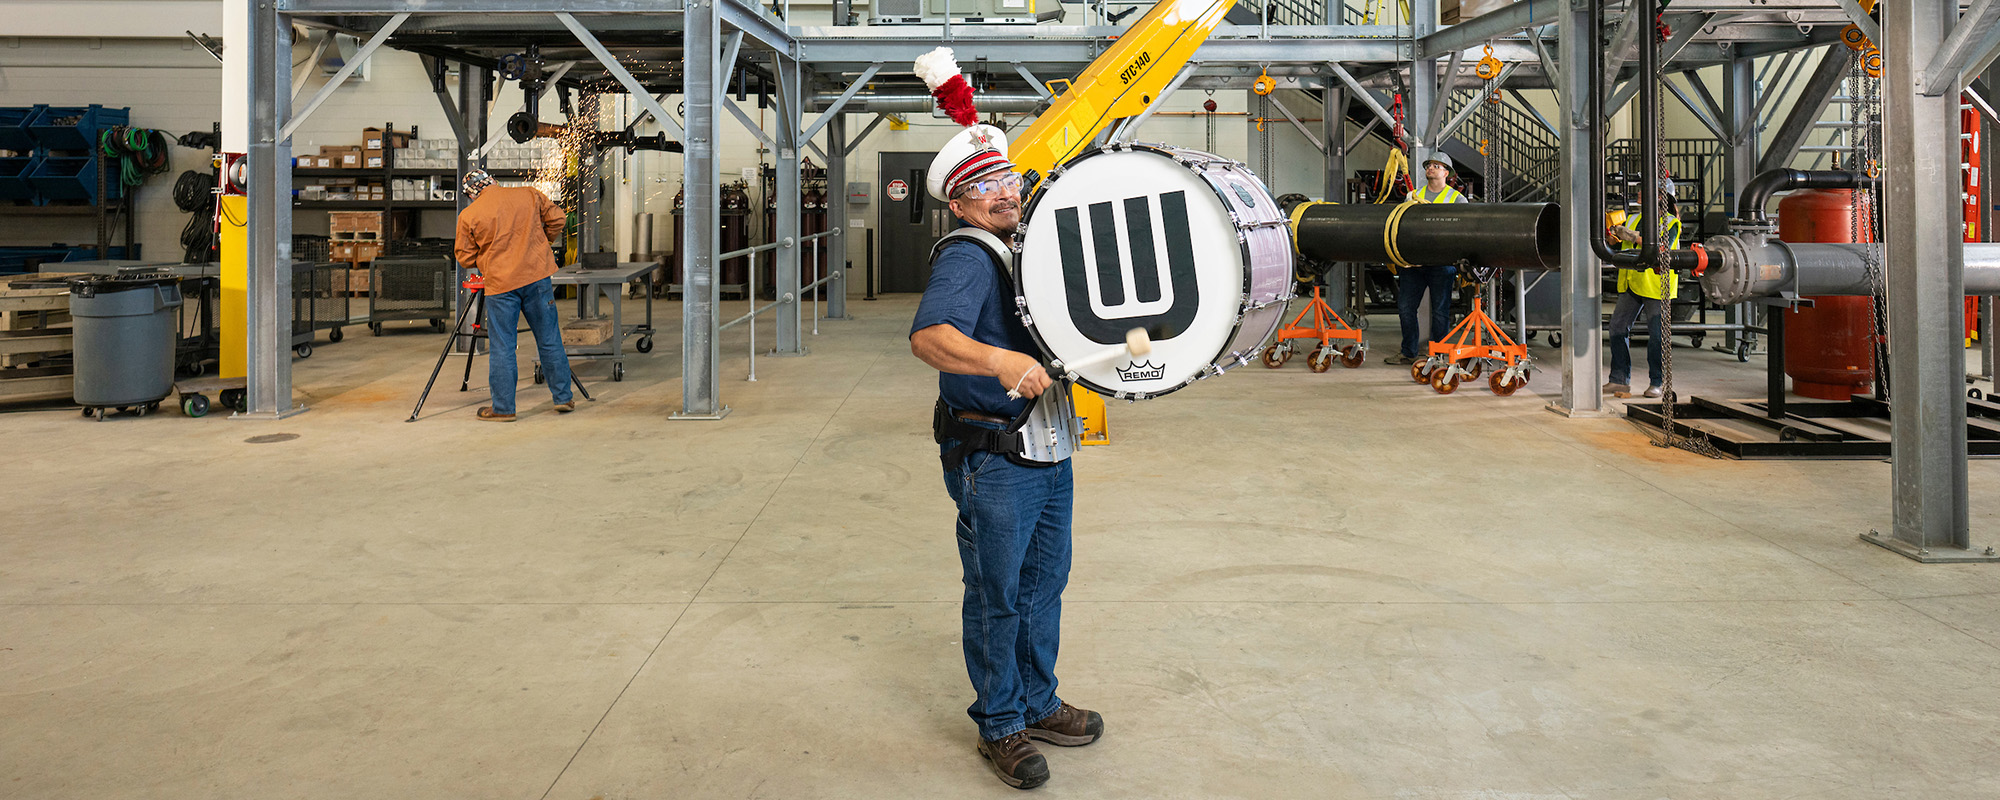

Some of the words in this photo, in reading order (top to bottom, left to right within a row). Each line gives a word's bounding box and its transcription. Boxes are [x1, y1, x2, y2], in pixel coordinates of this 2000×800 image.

[1120, 51, 1150, 85] STC-140
[978, 134, 987, 144] W
[1124, 370, 1160, 379] REMO
